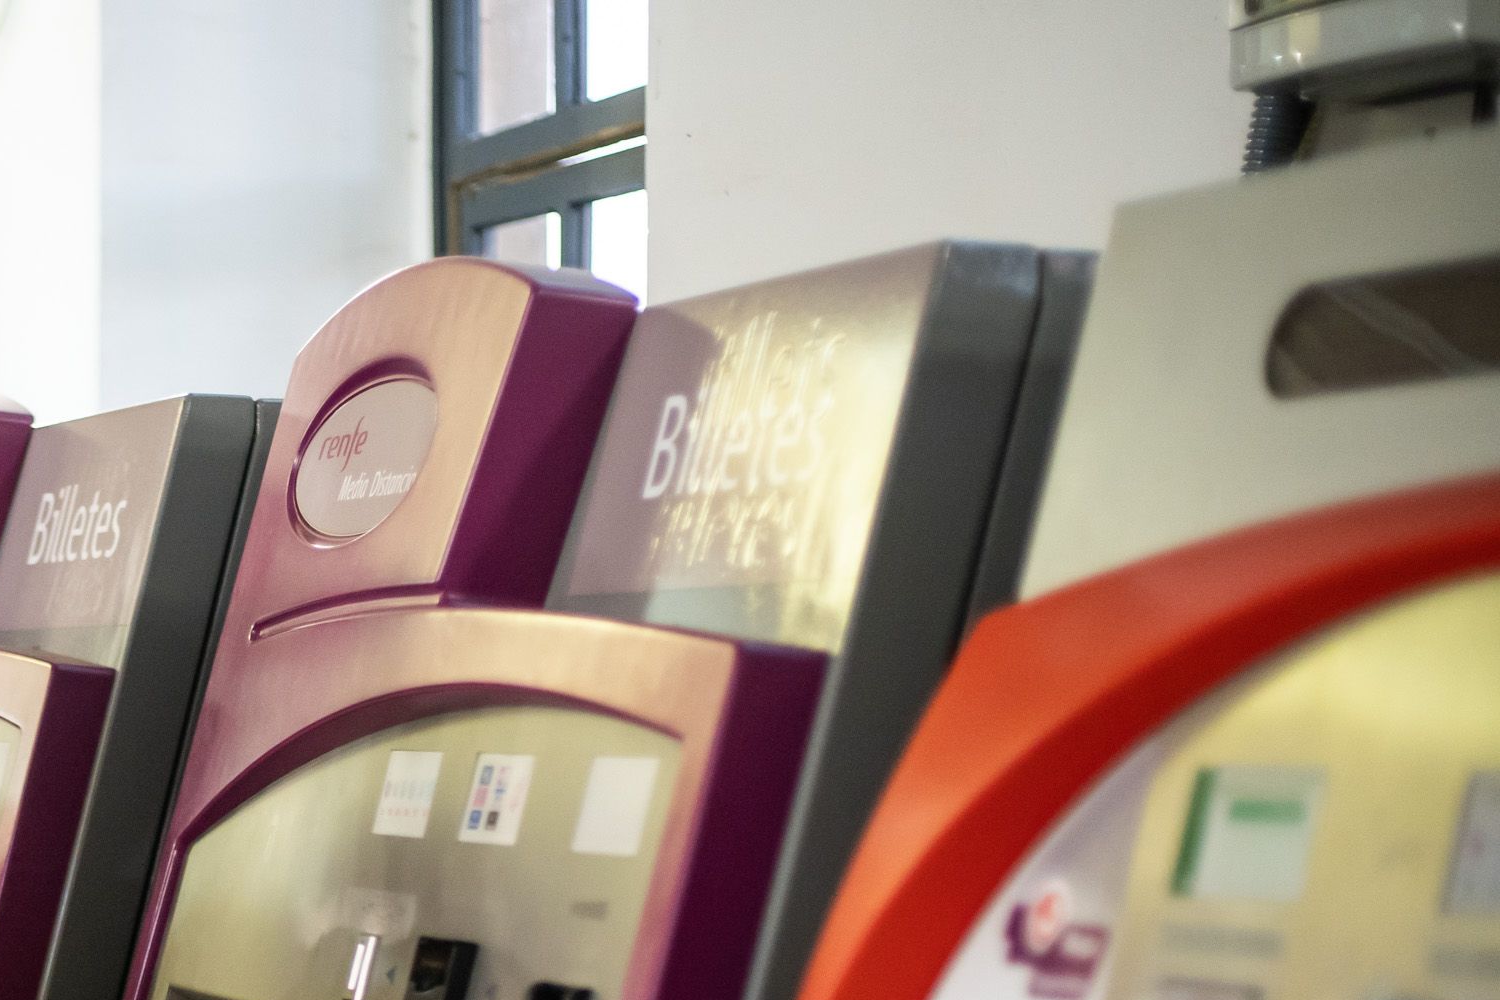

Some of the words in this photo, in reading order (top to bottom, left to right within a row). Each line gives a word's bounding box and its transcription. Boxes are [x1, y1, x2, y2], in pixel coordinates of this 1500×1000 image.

[318, 415, 369, 473] renfe
[642, 385, 837, 500] Billetes
[337, 471, 369, 502] Media
[369, 465, 417, 498] Distanci
[26, 483, 128, 566] Billetes
